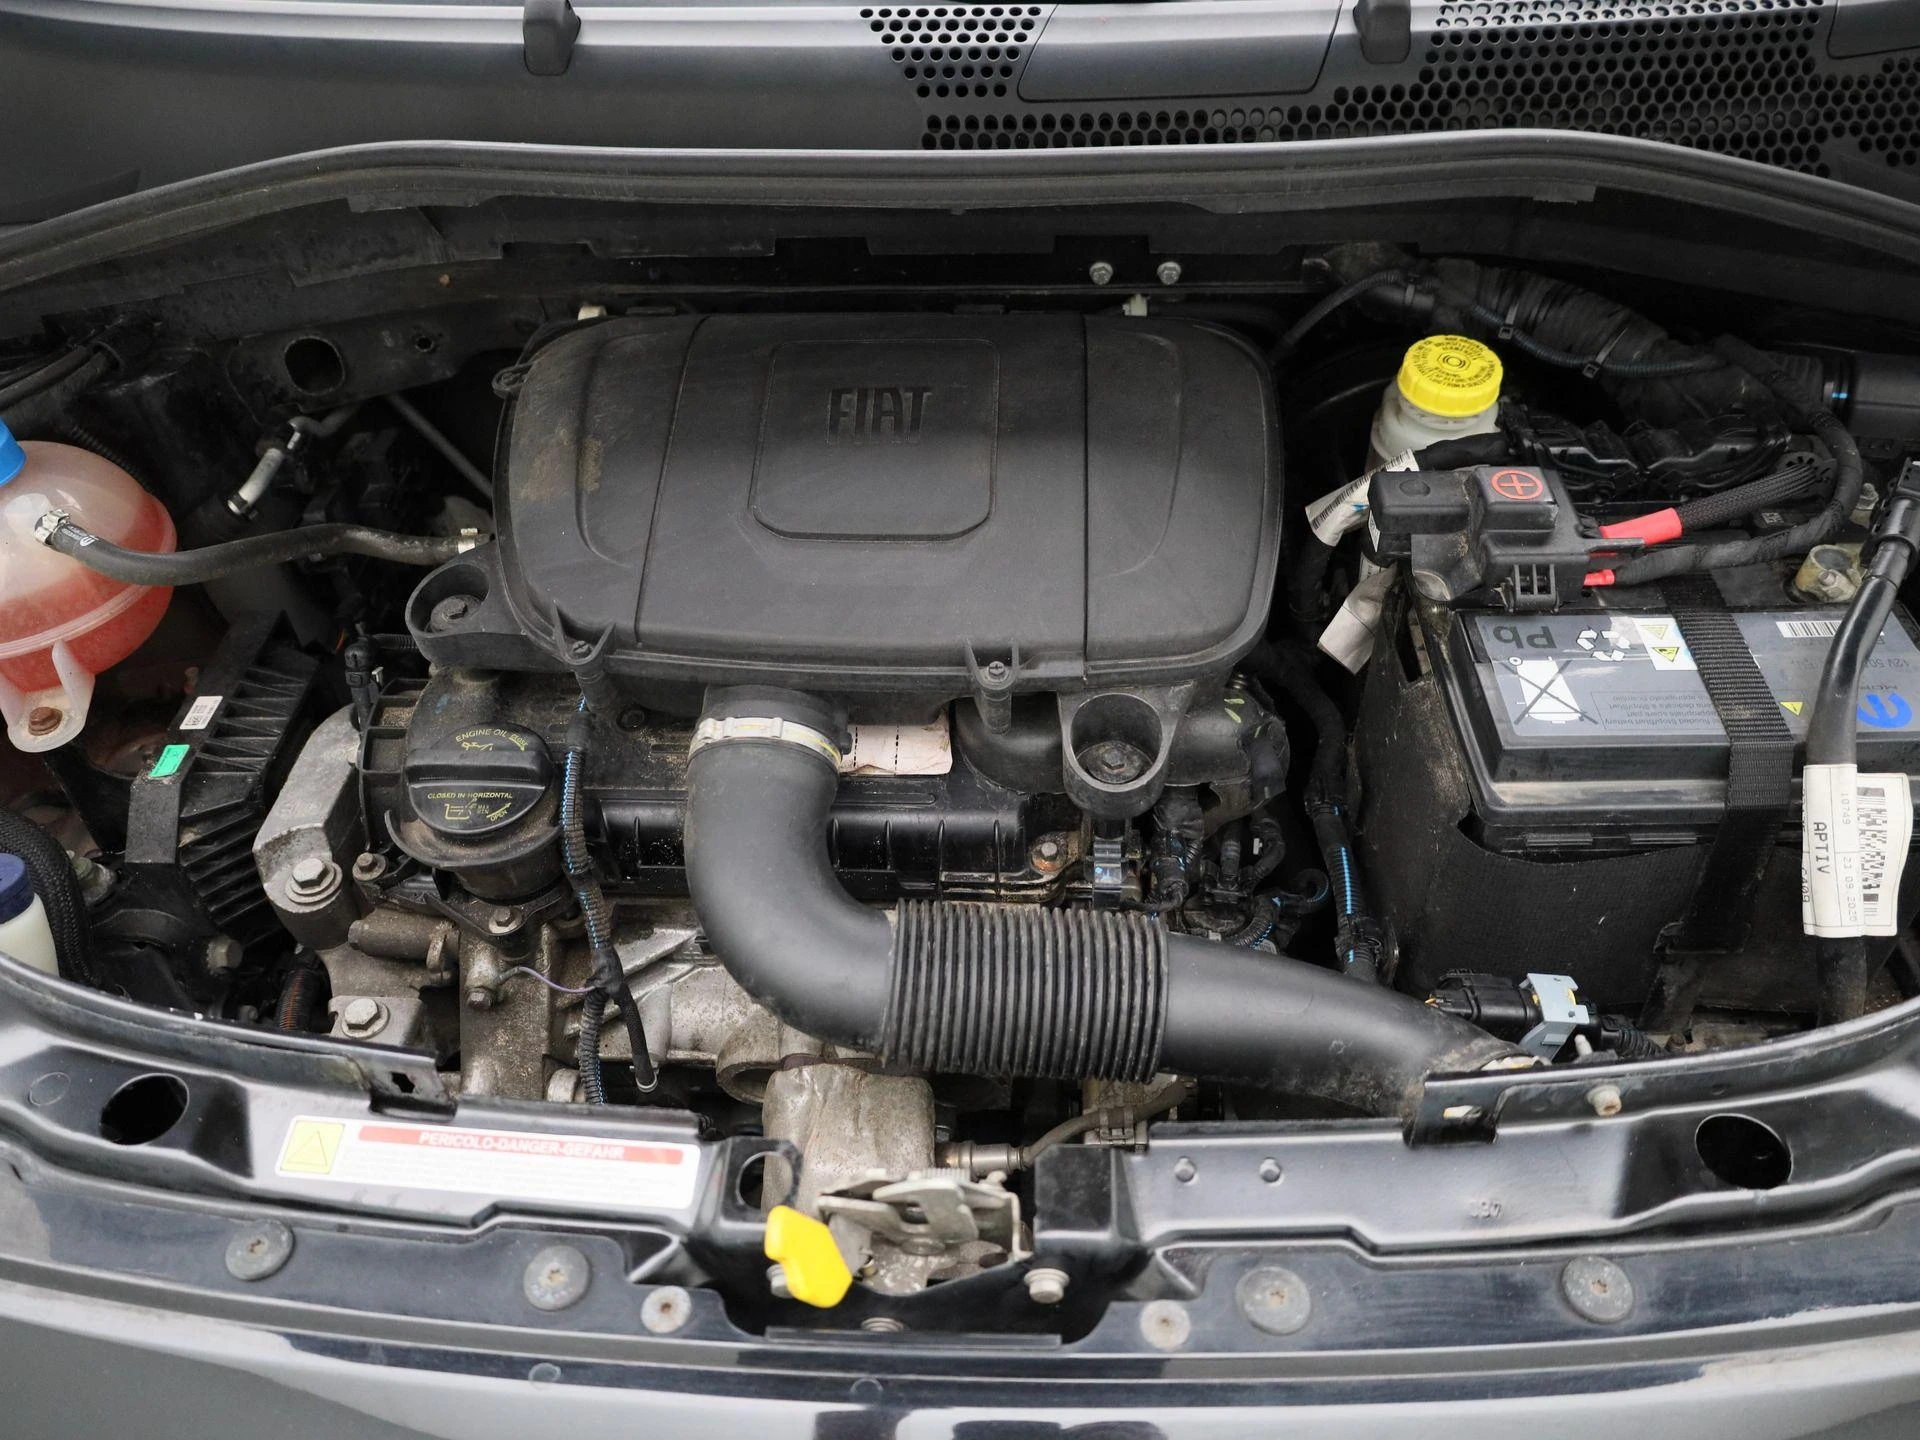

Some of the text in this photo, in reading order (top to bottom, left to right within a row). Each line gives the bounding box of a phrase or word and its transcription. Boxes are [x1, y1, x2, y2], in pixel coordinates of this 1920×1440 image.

[826, 386, 934, 444] FIAT
[1493, 626, 1557, 648] Pb
[455, 729, 507, 742] ENGINE OIL
[427, 792, 456, 800] CLOSED
[467, 791, 513, 799] HORIZONTAL
[490, 810, 508, 822] OPEN
[1813, 821, 1831, 875] APTIV
